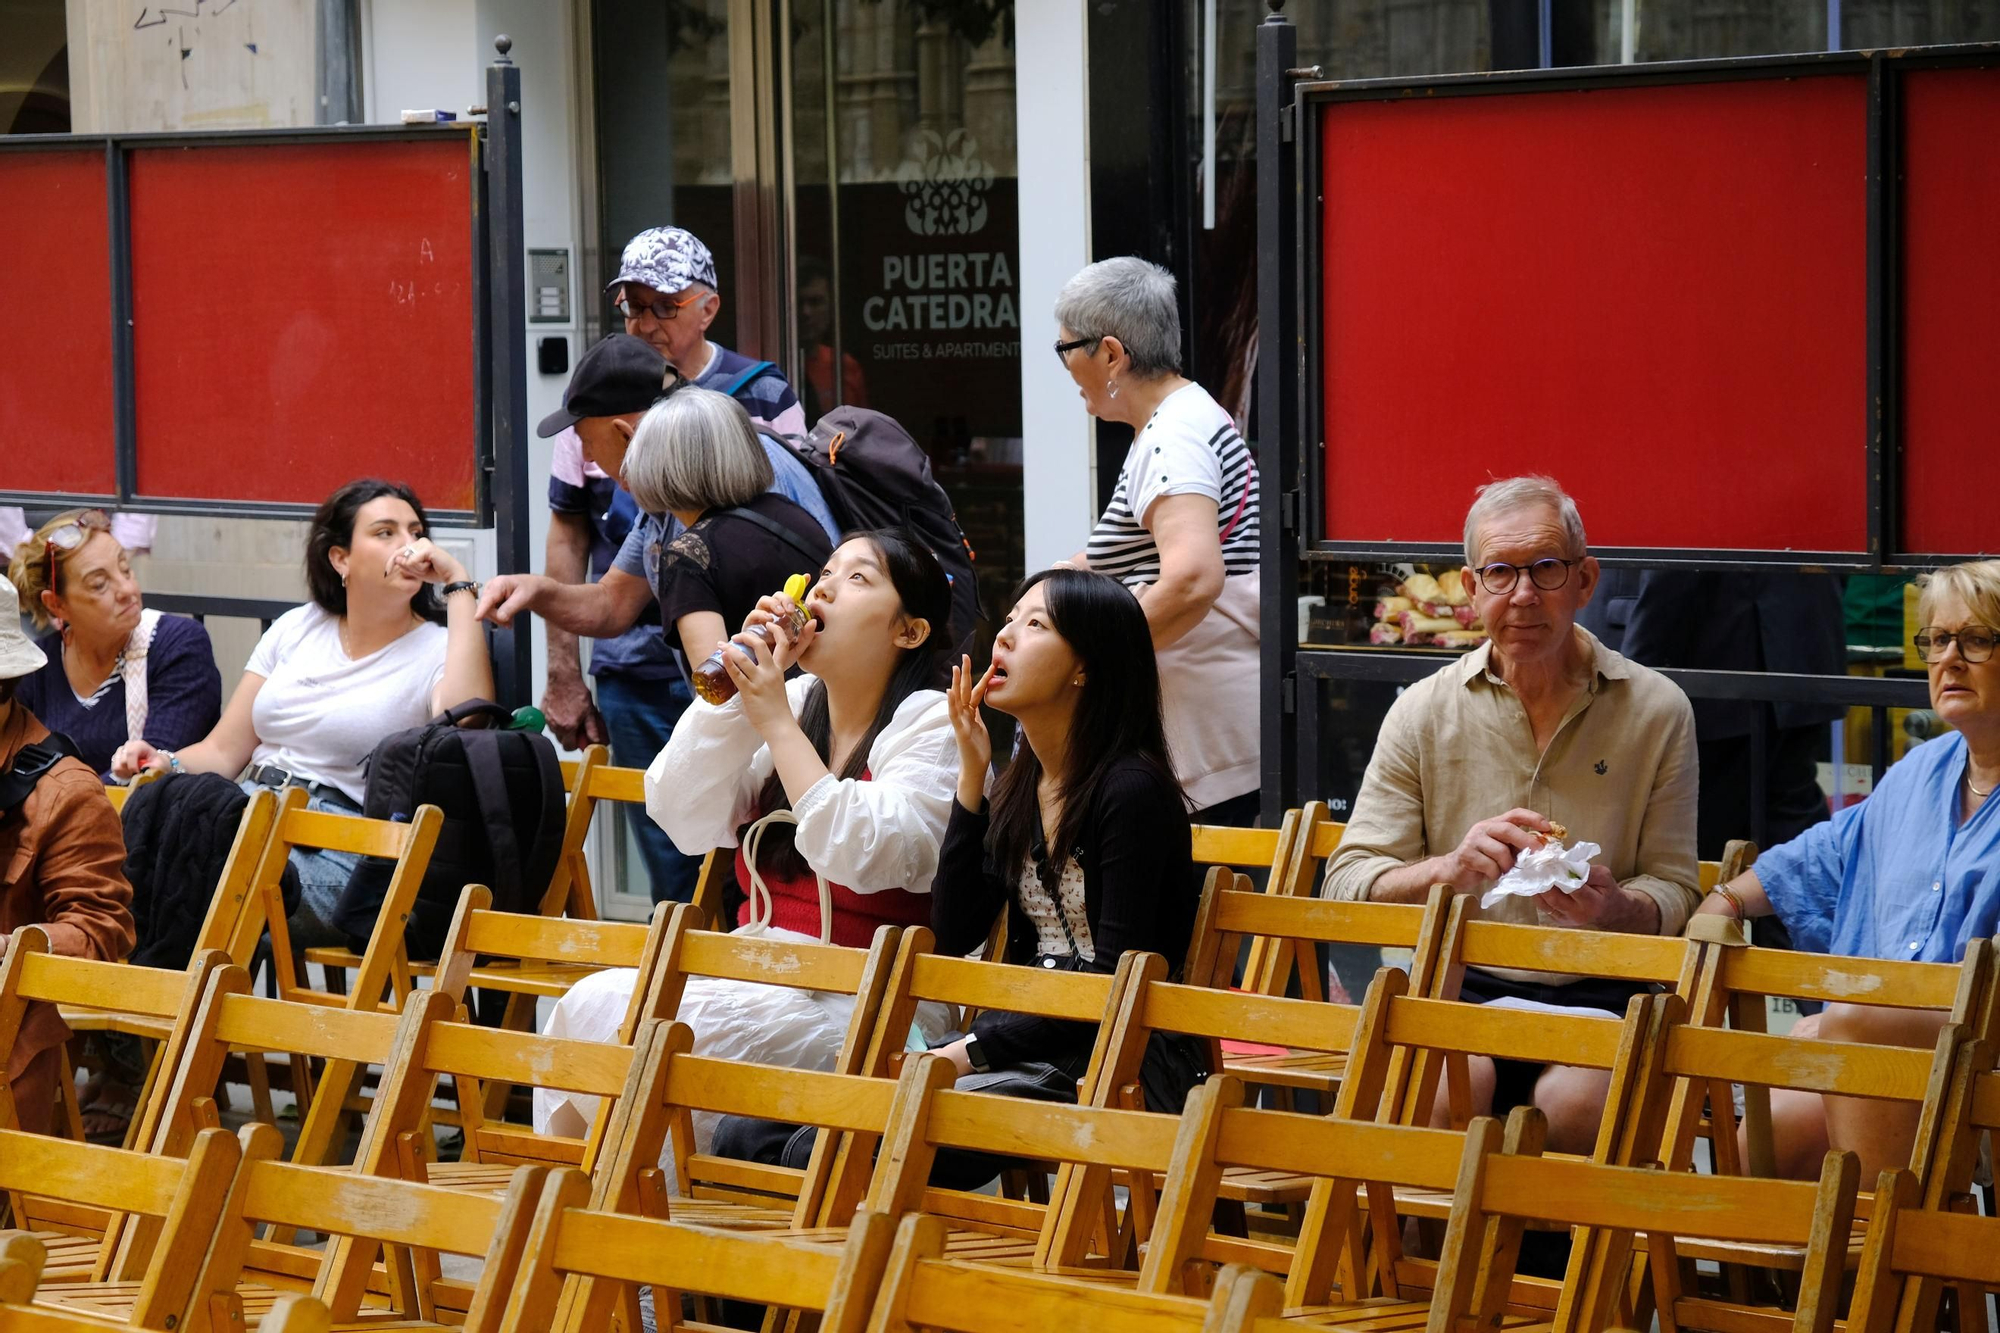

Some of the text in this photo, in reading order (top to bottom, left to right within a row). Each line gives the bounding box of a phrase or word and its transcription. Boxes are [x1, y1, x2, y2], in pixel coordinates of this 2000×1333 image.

[883, 252, 1013, 290] PUERTA
[862, 293, 1019, 331] CATEDRA
[873, 340, 1021, 360] SUITES & APARTMENT
